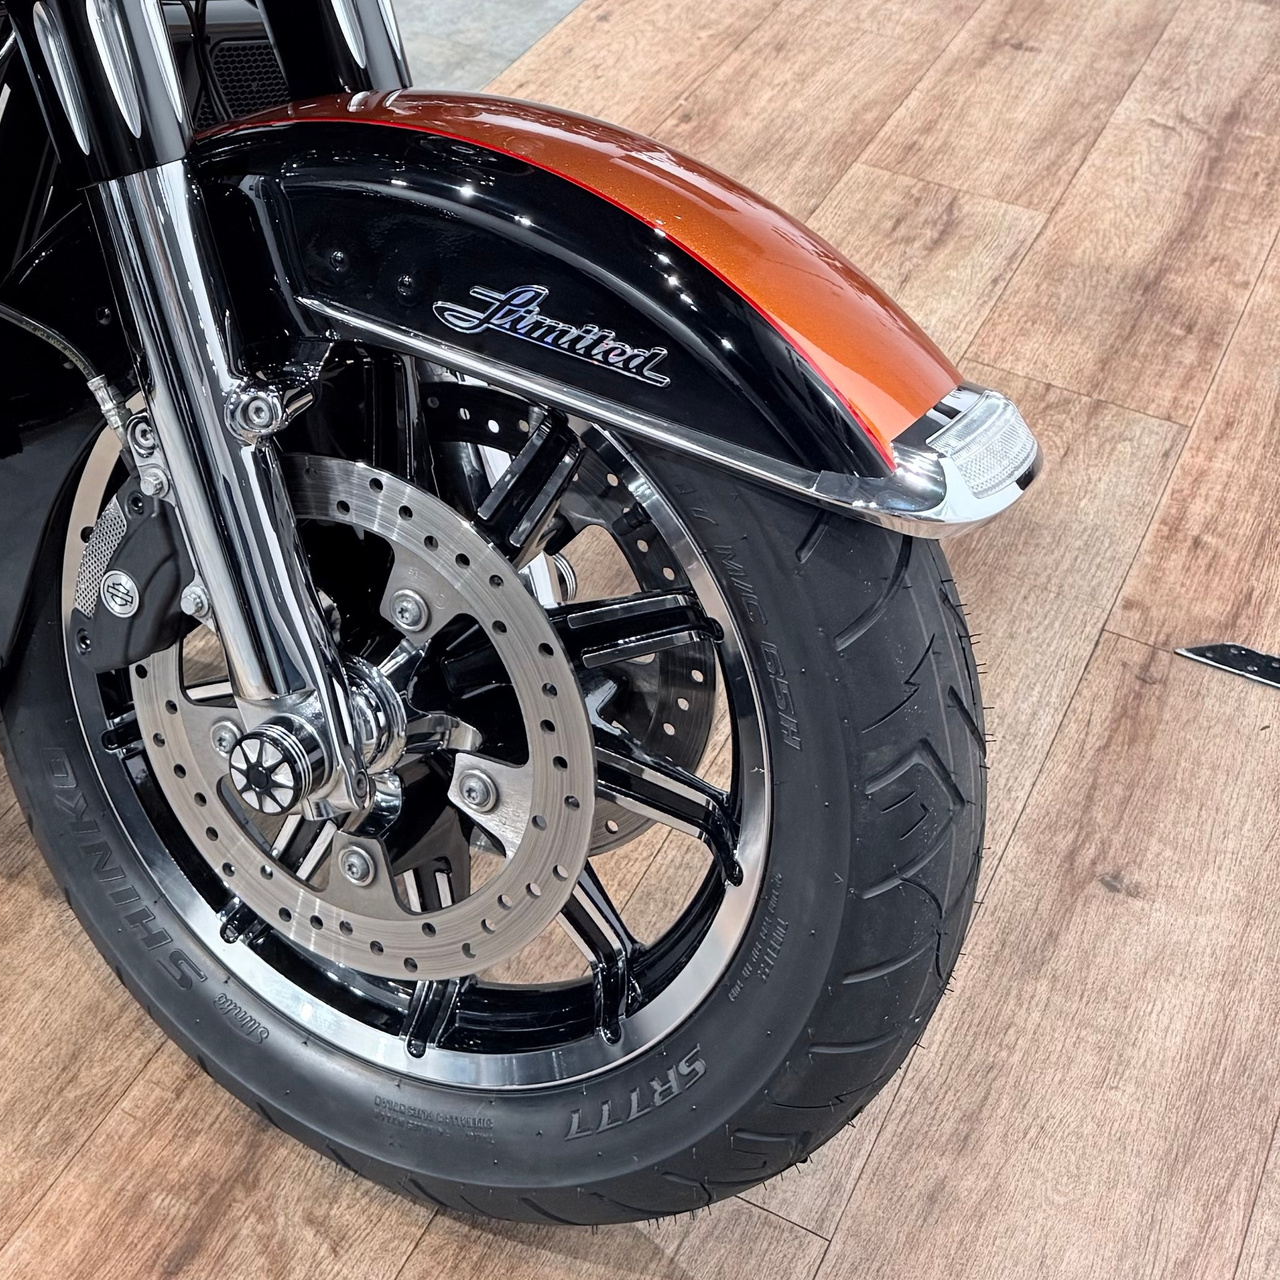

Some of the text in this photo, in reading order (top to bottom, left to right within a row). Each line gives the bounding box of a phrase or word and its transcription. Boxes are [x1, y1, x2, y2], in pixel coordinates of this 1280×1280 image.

[433, 285, 671, 387] Limited
[42, 748, 207, 991] SHINKO
[214, 992, 269, 1045] Shinko
[565, 1043, 707, 1141] SR777
